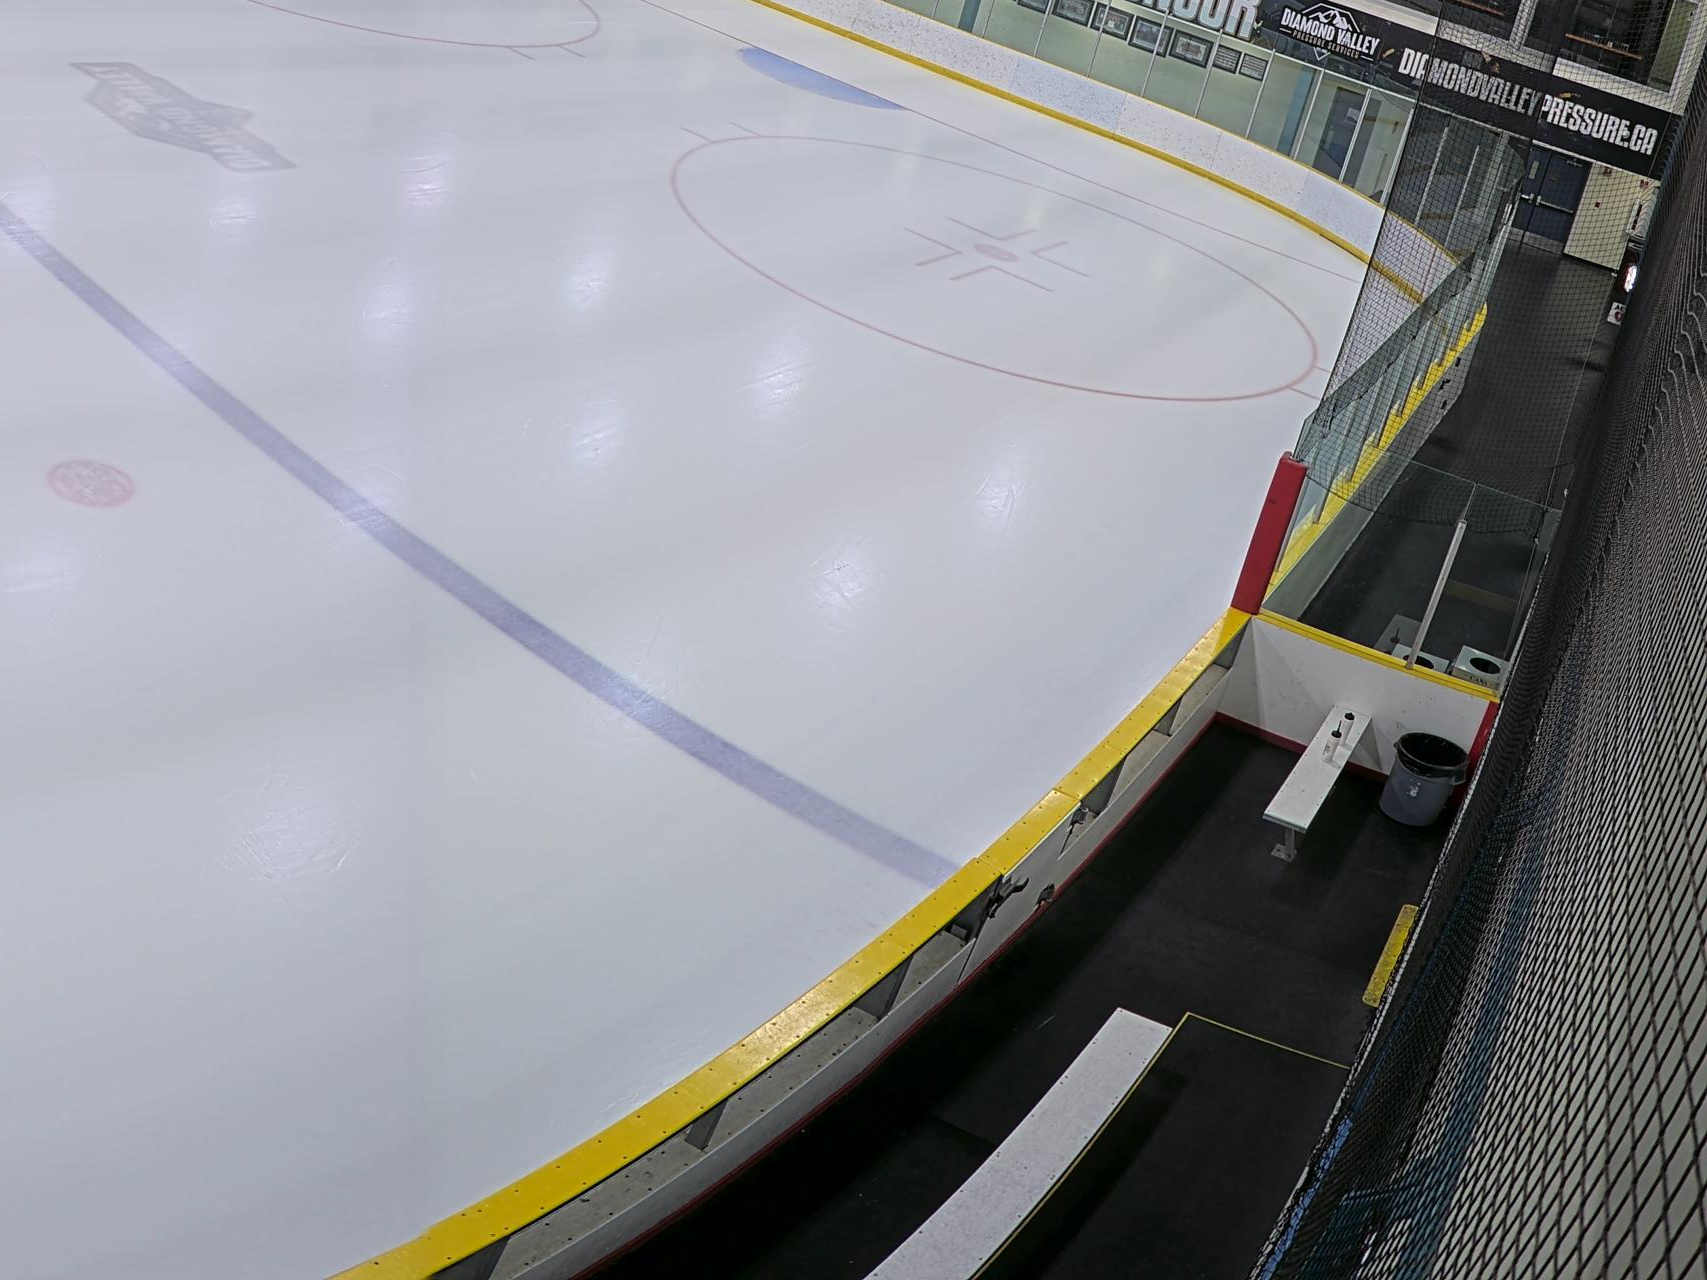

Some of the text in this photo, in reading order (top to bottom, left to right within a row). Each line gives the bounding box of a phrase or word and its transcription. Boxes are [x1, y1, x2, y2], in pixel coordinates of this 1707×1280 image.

[1280, 7, 1380, 57] DIAMOND VALLEY
[1292, 31, 1360, 60] PRESSURE SERVICES
